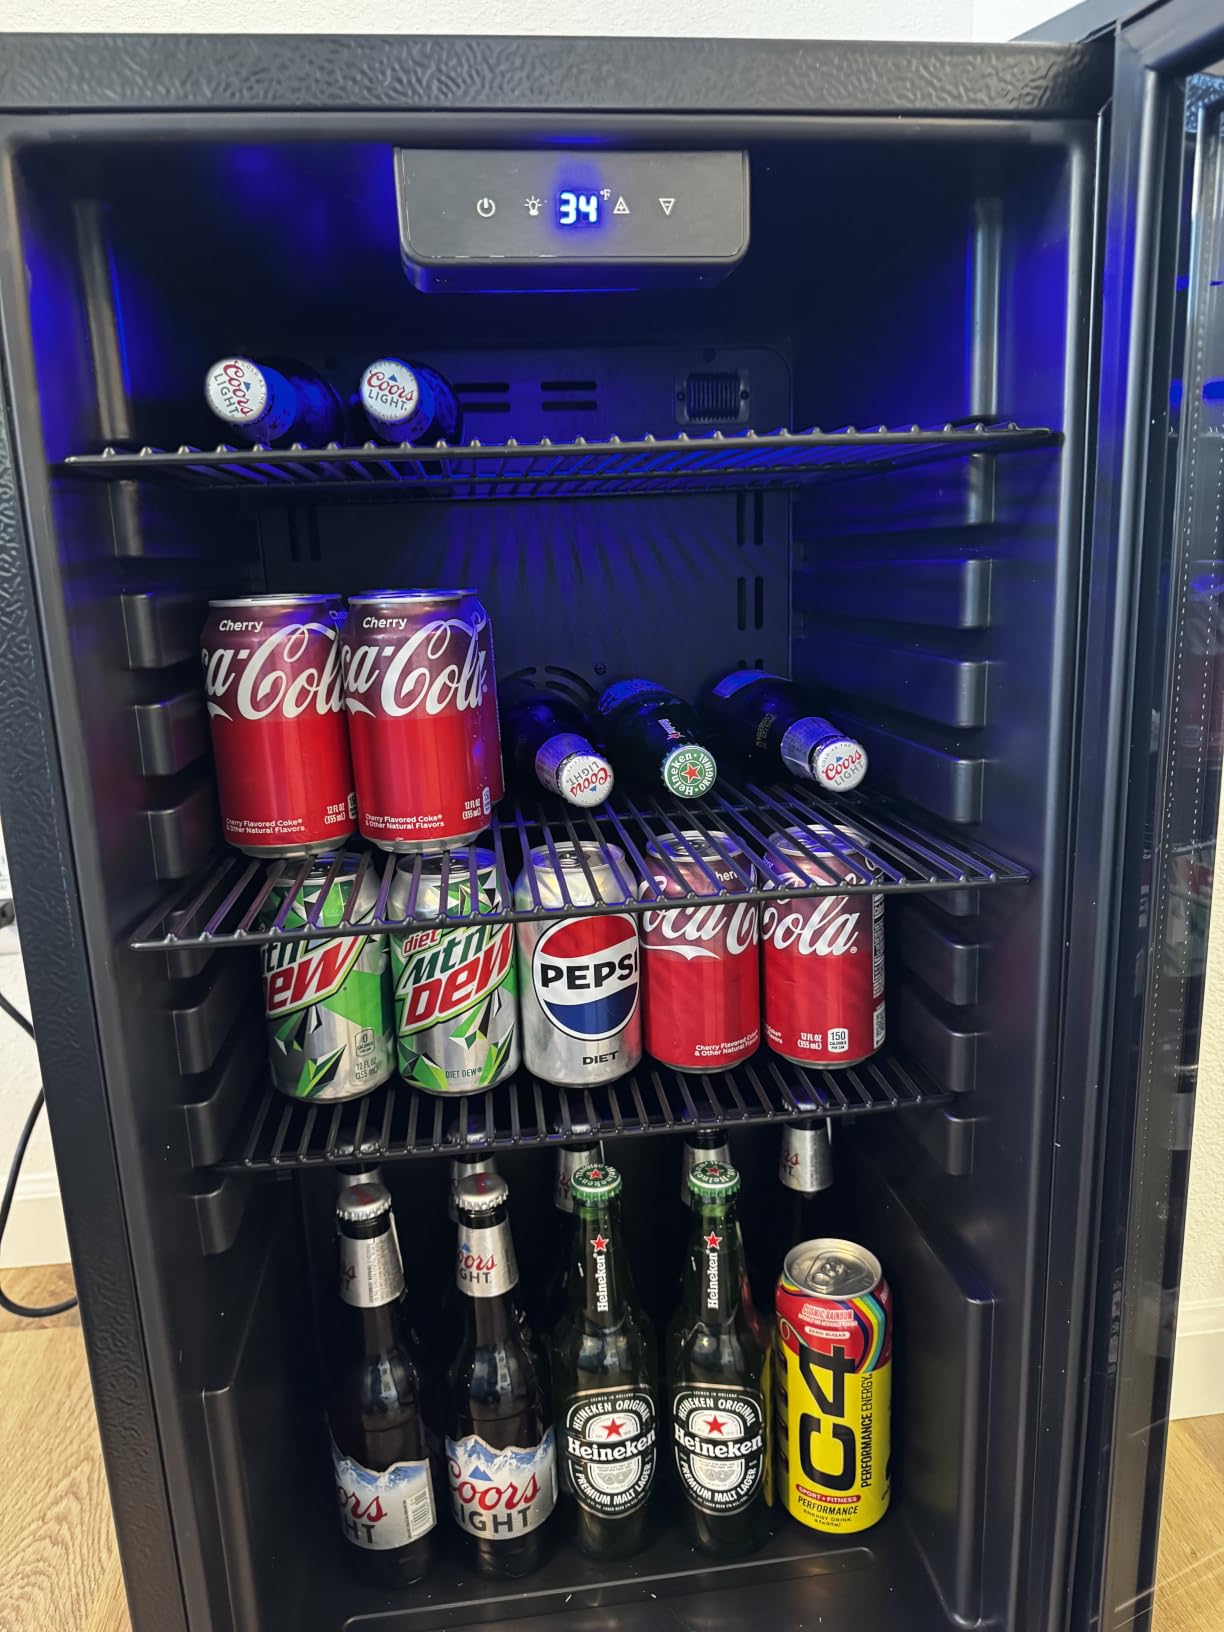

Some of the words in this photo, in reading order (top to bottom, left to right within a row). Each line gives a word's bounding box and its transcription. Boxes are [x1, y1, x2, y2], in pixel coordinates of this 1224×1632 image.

[559, 192, 598, 225] 34
[214, 373, 239, 413] LIGHT
[223, 360, 254, 416] Coors
[367, 370, 414, 401] Coors
[219, 620, 263, 632] Cherry
[362, 616, 407, 629] Cherry
[567, 761, 600, 786] LIGHT
[671, 752, 693, 795] Heineken
[698, 753, 714, 791] ORIGINAL
[822, 749, 862, 780] Coors
[834, 762, 864, 786] LIGHT
[570, 767, 611, 797] Coors
[246, 826, 273, 834] Natural
[275, 825, 305, 833] Flavors
[365, 813, 383, 822] Cherry
[416, 821, 445, 829] Flavors
[403, 928, 440, 954] diet
[401, 925, 488, 990] Mtn
[701, 1049, 721, 1057] Other
[722, 1043, 745, 1054] Natural
[721, 1037, 746, 1049] Flavored
[800, 1032, 806, 1040] 12
[831, 1030, 846, 1041] 150
[582, 1051, 619, 1065] DIET
[446, 1070, 460, 1079] DIET
[594, 1254, 608, 1312] Heineken
[706, 1252, 719, 1309] Heineken
[573, 1402, 613, 1431] HEINEKEN
[616, 1399, 651, 1423] ORIGINAL
[678, 1397, 714, 1421] HEINEKEN
[718, 1399, 756, 1427] ORIGINAL
[799, 1344, 856, 1491] C4
[567, 1429, 656, 1461] Heineken
[674, 1422, 763, 1458] Heineken
[860, 1412, 873, 1488] PERFORMANCE
[575, 1473, 611, 1505] PREMIUM
[613, 1488, 636, 1505] MALT
[635, 1462, 652, 1492] LAGER
[680, 1461, 712, 1500] PREMIUM
[714, 1490, 738, 1502] MALT
[737, 1467, 757, 1495] LAGER
[798, 1486, 821, 1500] SPORT
[797, 1495, 859, 1515] PERFORMANCE
